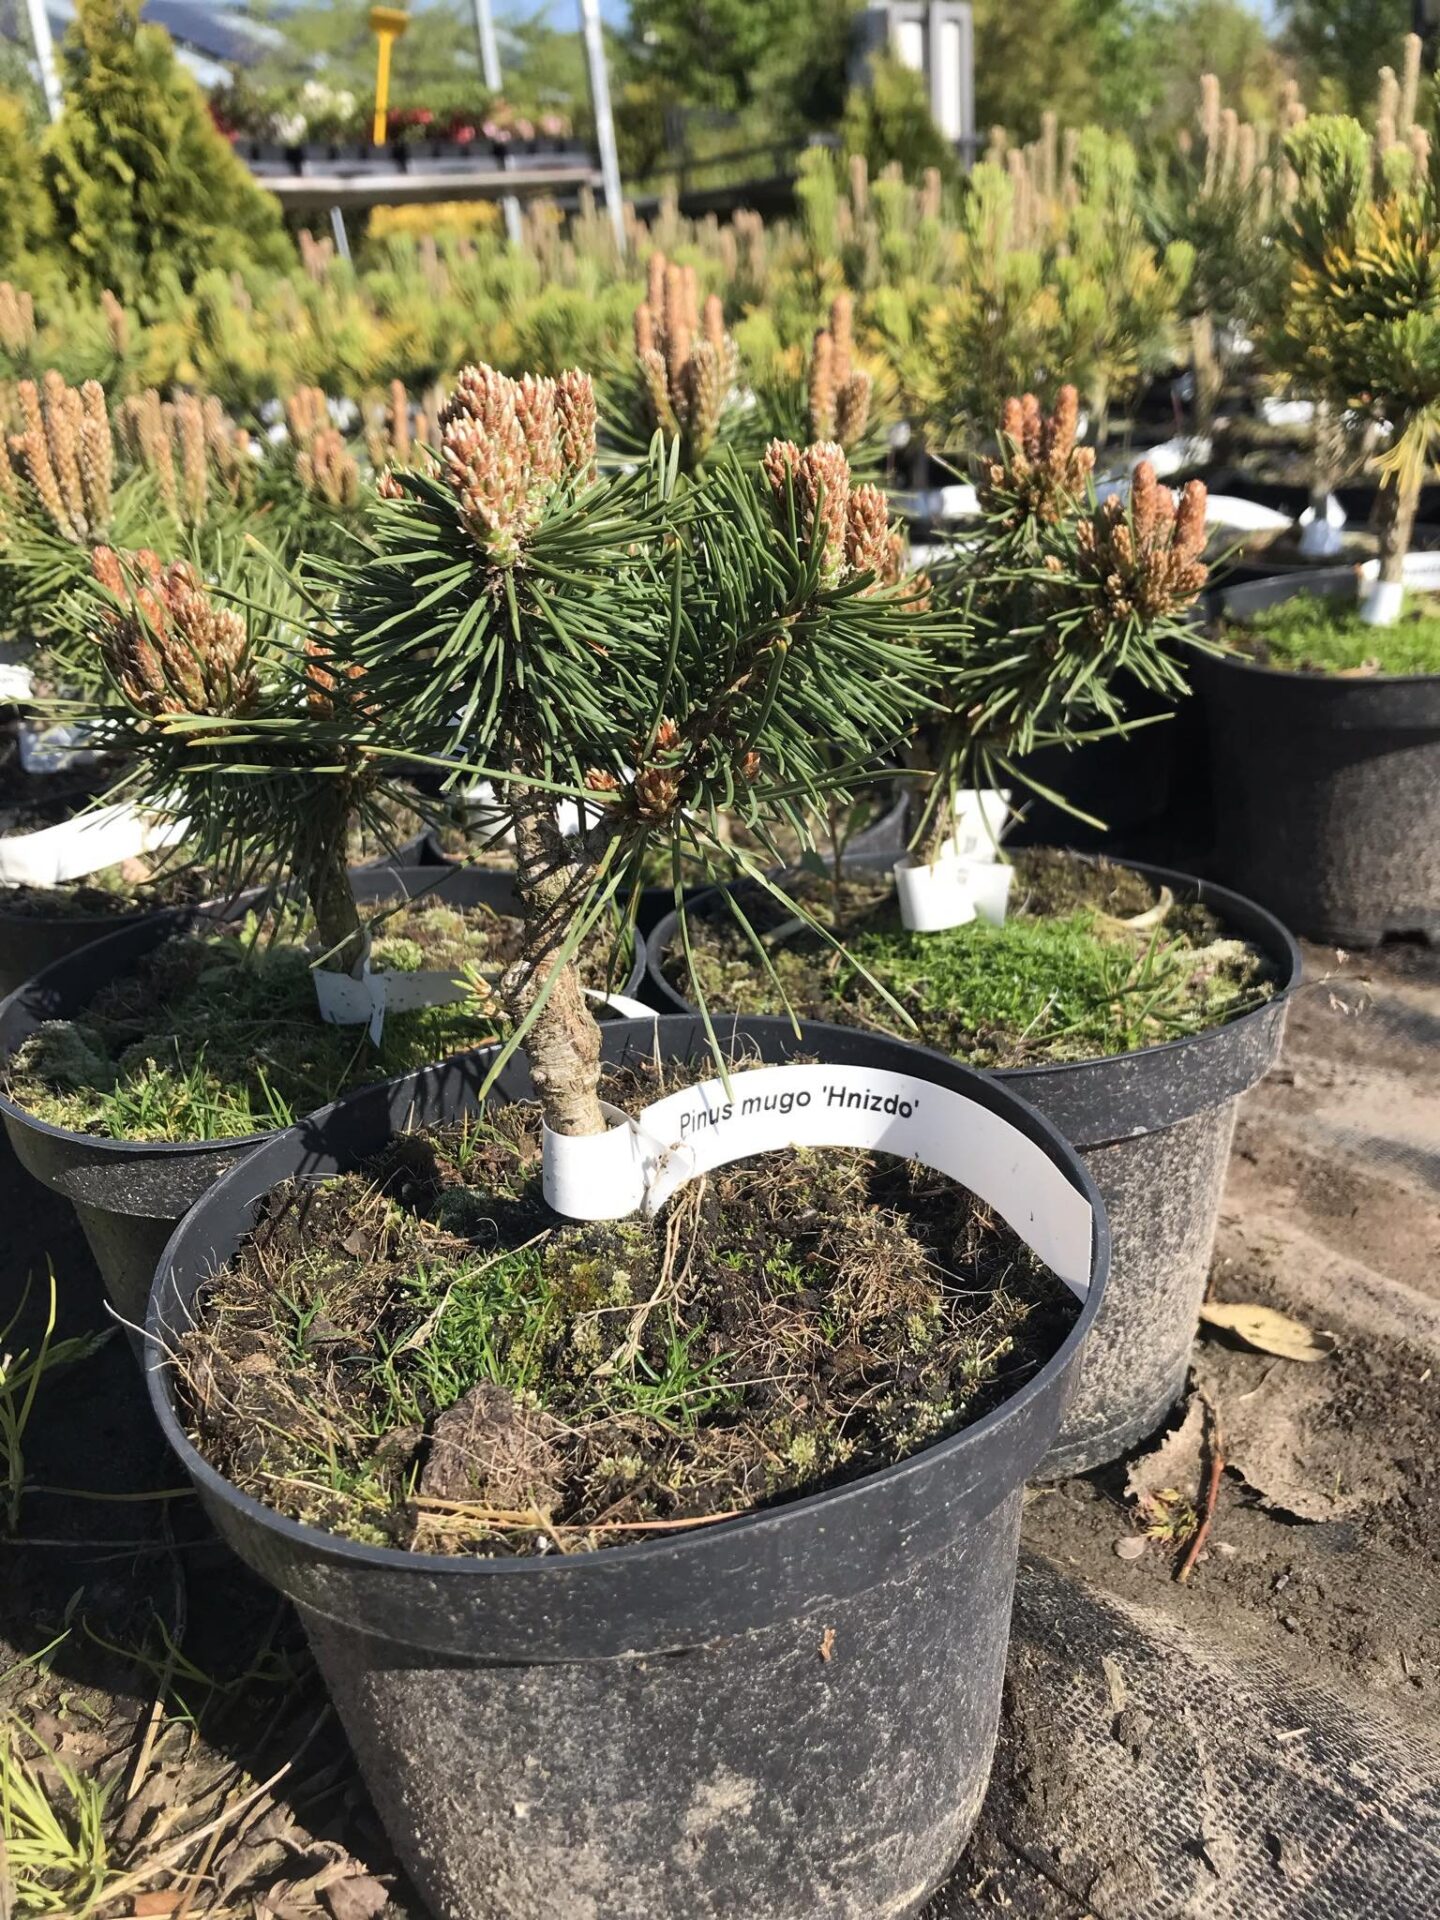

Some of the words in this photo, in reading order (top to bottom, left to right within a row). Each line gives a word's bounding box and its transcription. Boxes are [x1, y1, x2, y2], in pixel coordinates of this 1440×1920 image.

[680, 1103, 732, 1137] Pinus
[741, 1090, 812, 1114] mugo
[822, 1085, 919, 1119] 'Hnizdo'
